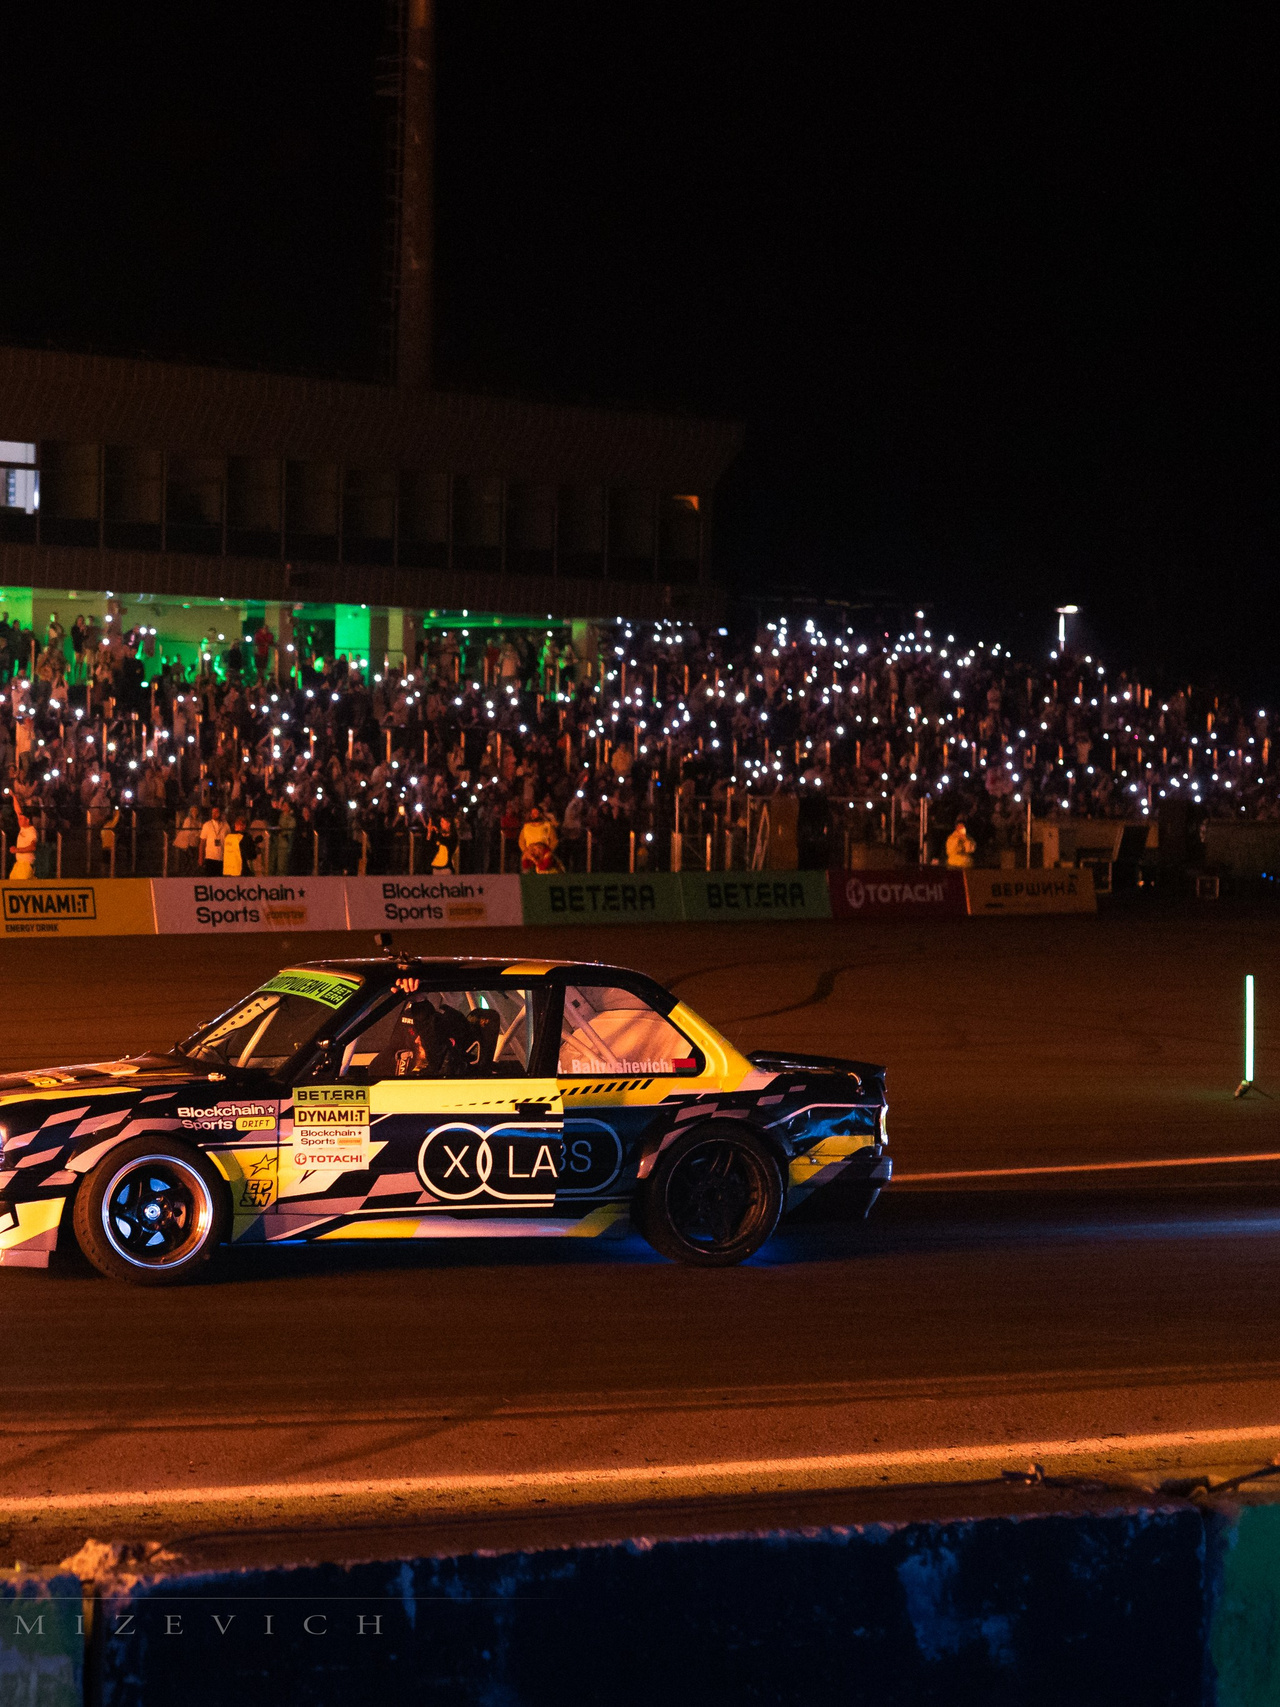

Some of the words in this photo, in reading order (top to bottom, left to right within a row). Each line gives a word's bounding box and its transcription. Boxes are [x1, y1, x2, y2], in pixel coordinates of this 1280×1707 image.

[194, 884, 295, 902] Blockchain
[382, 882, 475, 899] Blockchain
[706, 882, 806, 908] BETERA
[865, 883, 944, 902] TOTACHI
[548, 885, 657, 912] BETERA
[196, 906, 260, 927] Sports
[384, 903, 444, 923] Sports
[5, 924, 35, 933] ENERGY
[36, 923, 60, 932] DRINK
[297, 1090, 366, 1101] BETERA
[177, 1104, 265, 1118] Blockchain
[181, 1118, 234, 1131] Sports
[242, 1119, 271, 1128] DRIFT
[300, 1129, 356, 1137] Blockchain
[300, 1137, 336, 1146] Sports
[308, 1155, 363, 1163] TOTACHI
